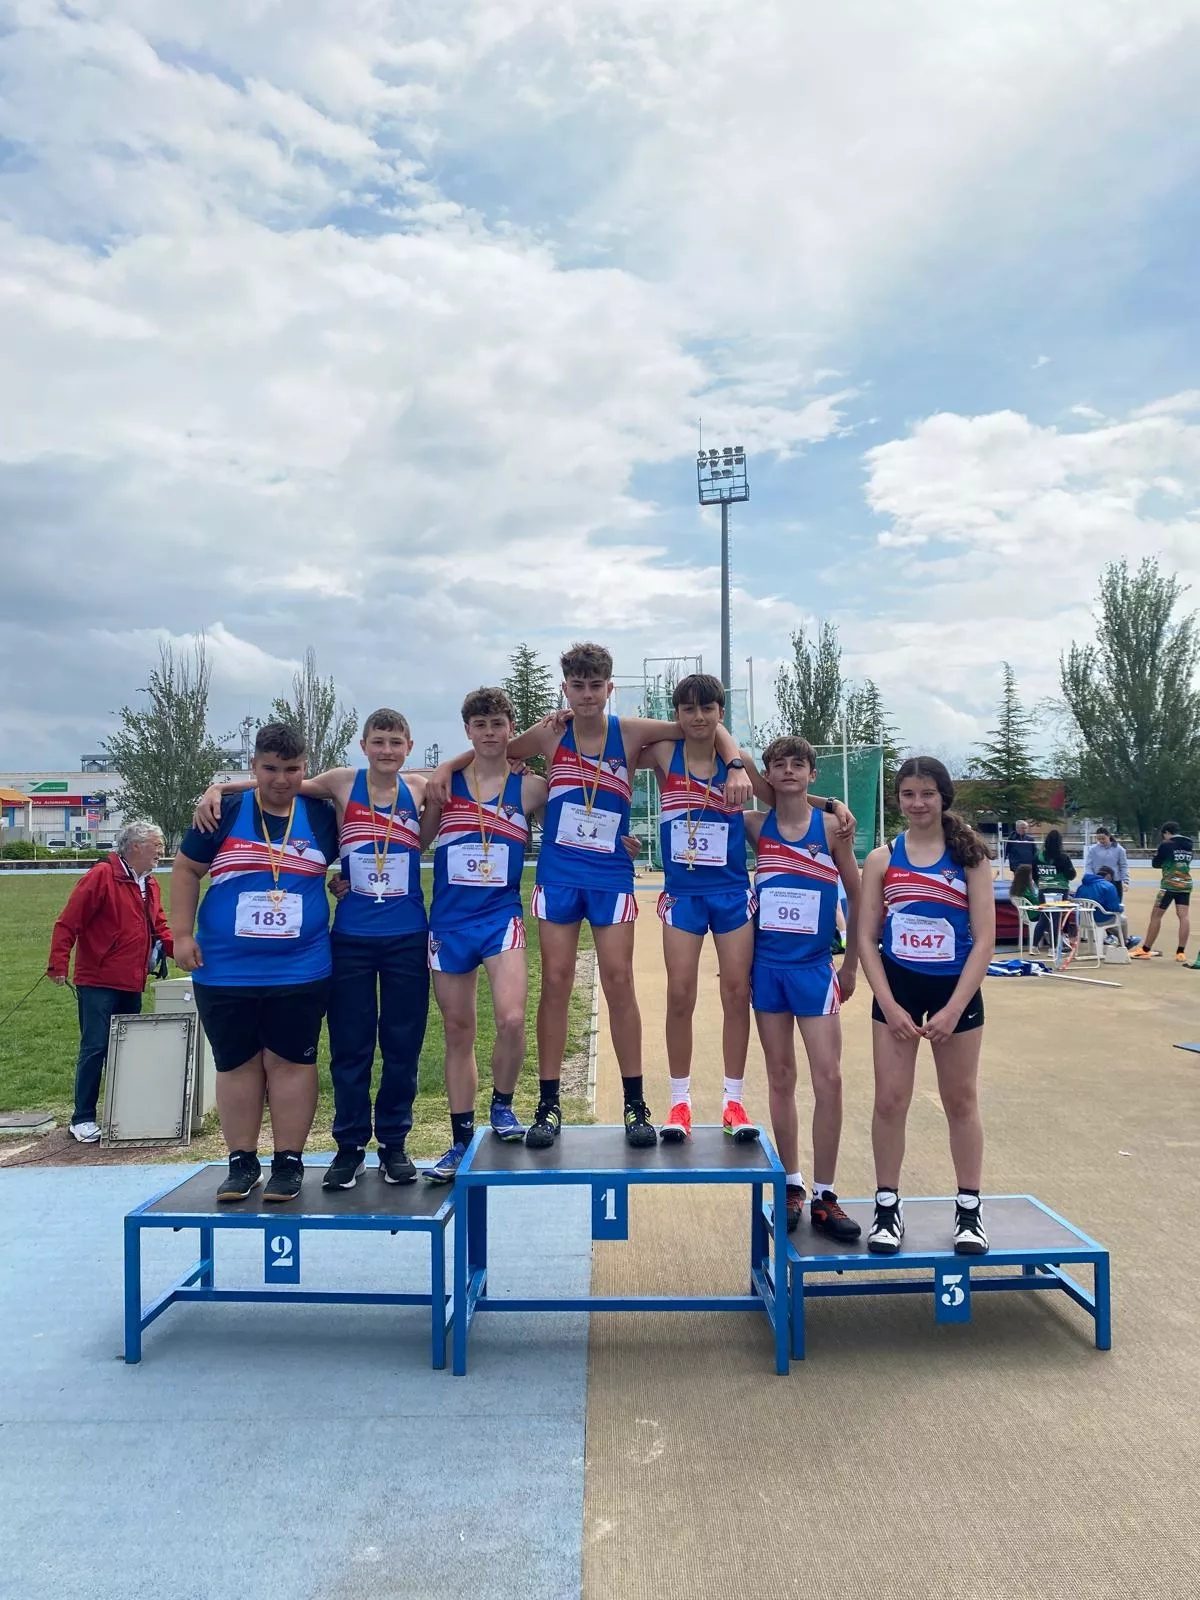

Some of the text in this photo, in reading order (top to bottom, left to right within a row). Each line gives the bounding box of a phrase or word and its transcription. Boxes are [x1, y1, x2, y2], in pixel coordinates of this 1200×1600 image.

[687, 837, 709, 851] 93
[251, 911, 287, 926] 183
[778, 906, 801, 921] 96
[899, 933, 945, 949] 1647
[601, 1188, 617, 1220] 1
[270, 1235, 293, 1267] 2
[941, 1274, 965, 1306] 3
